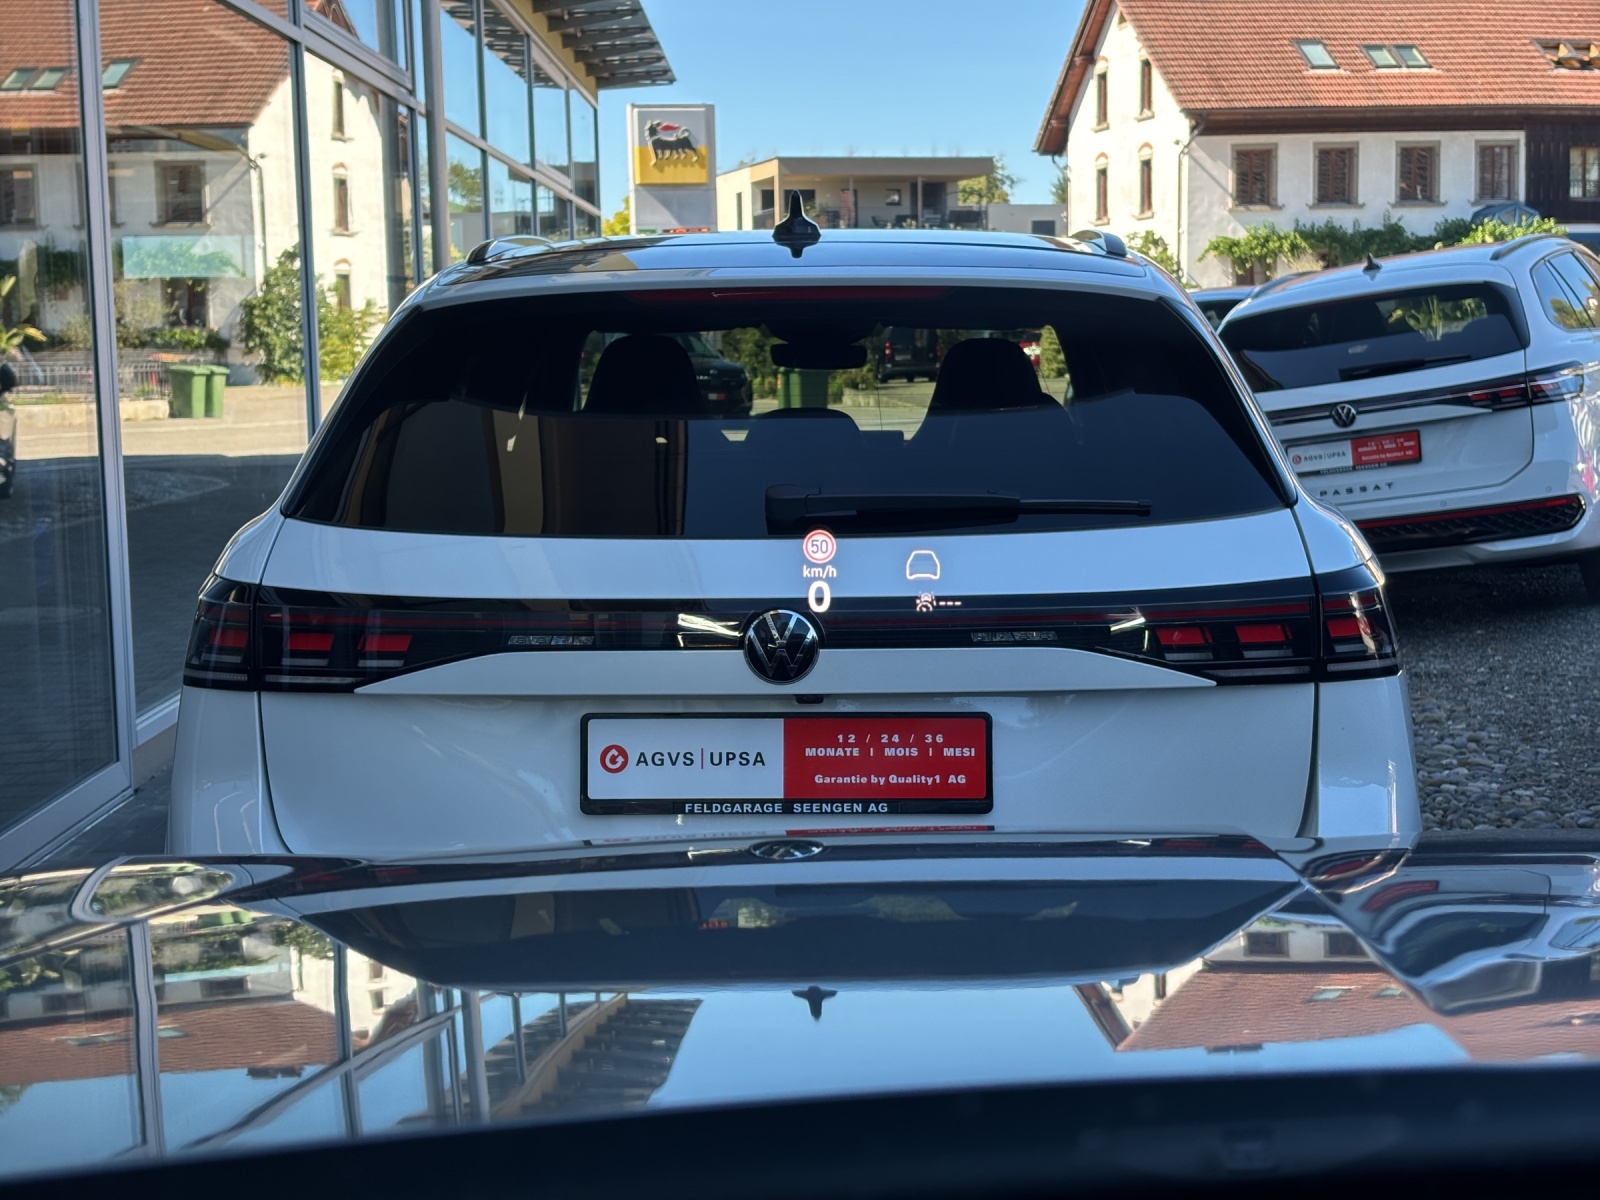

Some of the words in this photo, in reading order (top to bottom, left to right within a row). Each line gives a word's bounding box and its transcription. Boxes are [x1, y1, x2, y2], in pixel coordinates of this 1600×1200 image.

[1320, 482, 1394, 497] PASSAT
[810, 539, 829, 554] 50
[802, 564, 837, 578] km/h
[808, 580, 831, 613] 0
[837, 734, 856, 743] 12
[880, 734, 900, 743] 24
[924, 734, 944, 743] 36
[635, 751, 695, 767] AGVS
[709, 751, 766, 767] UPSA
[805, 747, 860, 757] MONATE
[884, 747, 919, 757] MOIS
[943, 747, 976, 757] MESI
[814, 774, 868, 784] Garantie
[870, 774, 886, 786] by
[888, 774, 941, 786] Quality1
[948, 774, 967, 784] AG
[684, 803, 783, 813] FELDGARAGE
[793, 803, 863, 813] SEENGEN
[868, 803, 888, 813] AG
